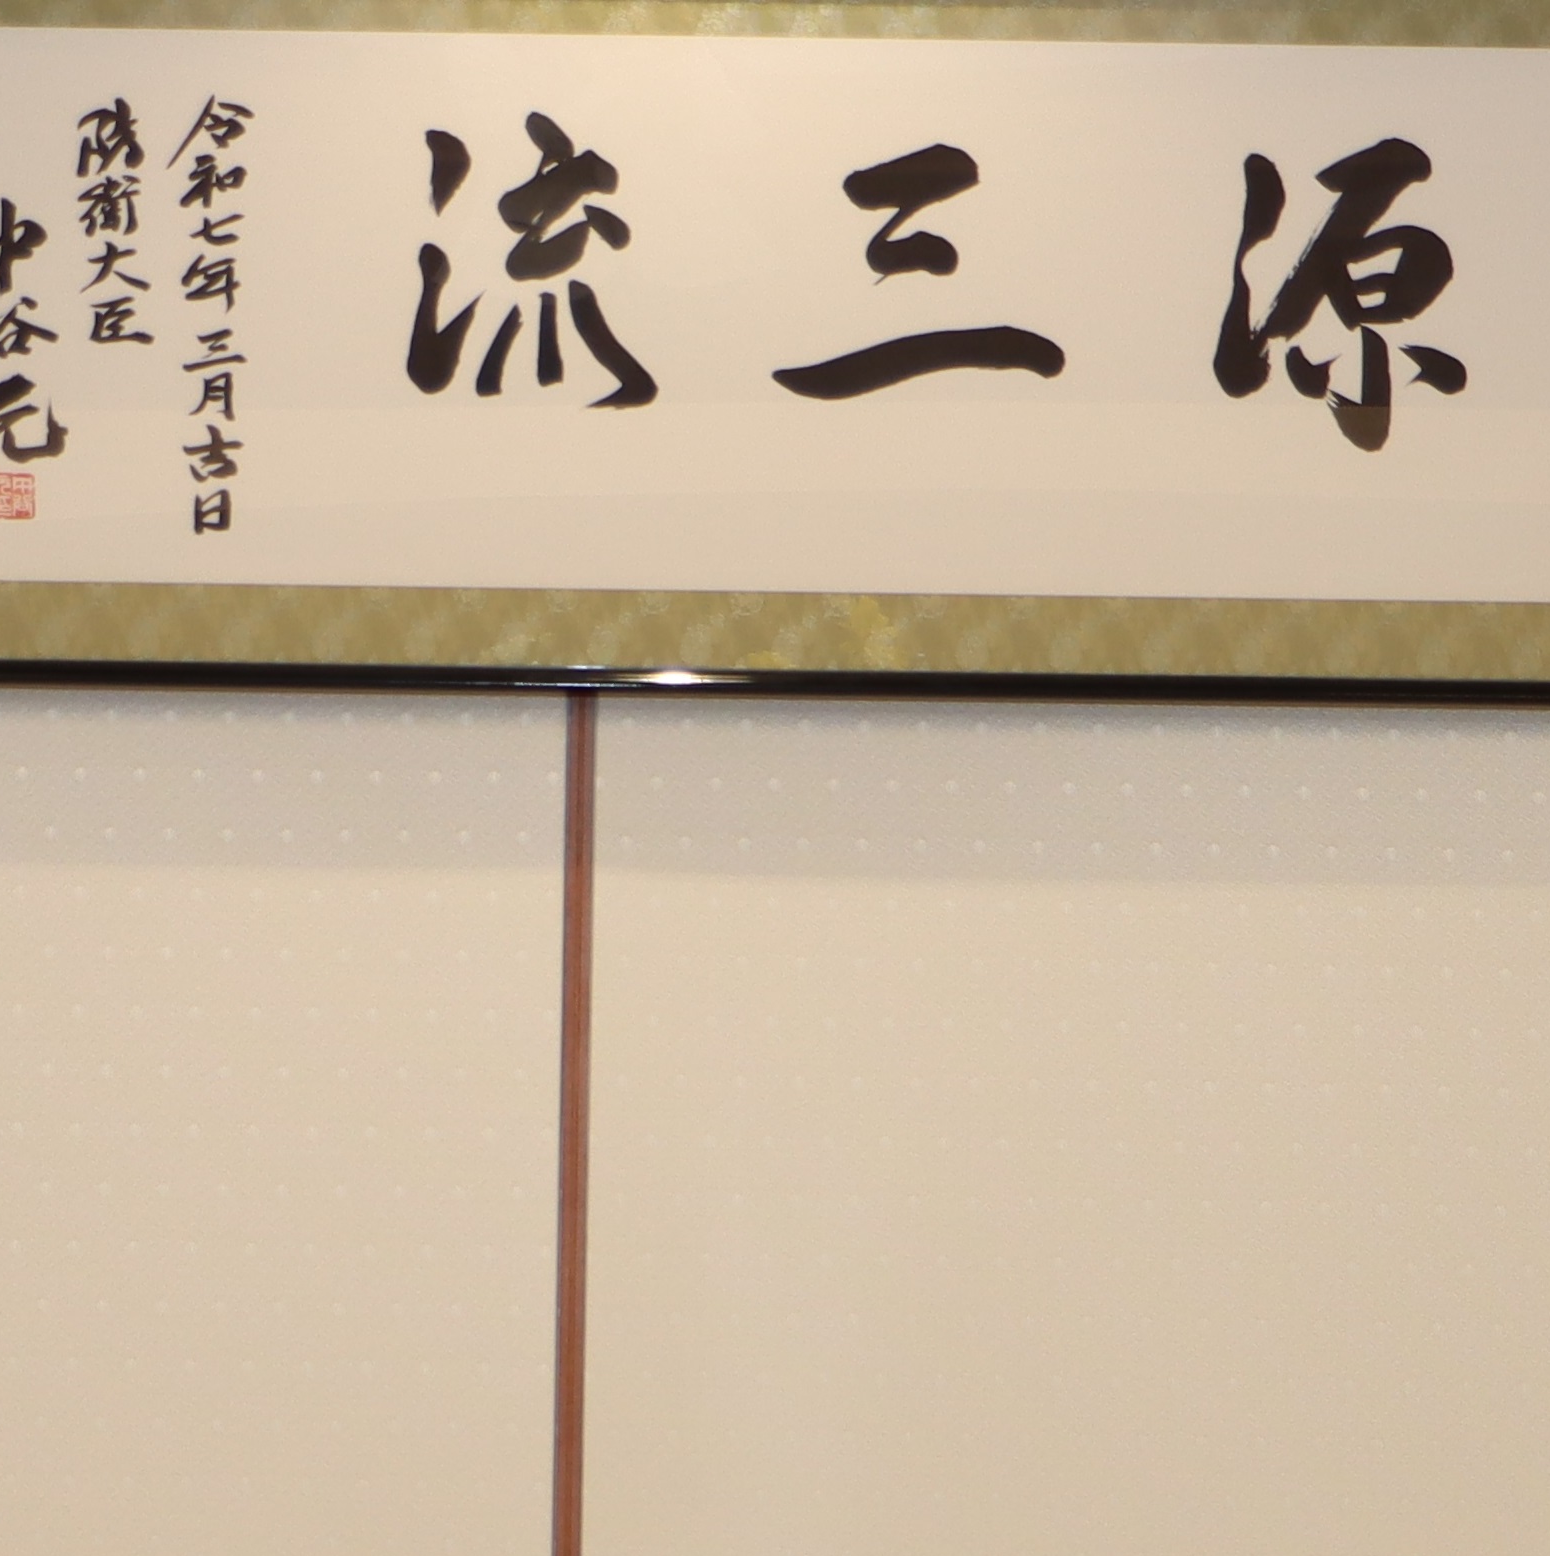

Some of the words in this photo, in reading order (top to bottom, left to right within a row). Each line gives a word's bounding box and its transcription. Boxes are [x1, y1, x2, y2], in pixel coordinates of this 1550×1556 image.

[167, 94, 254, 535] 令和七年三月吉日
